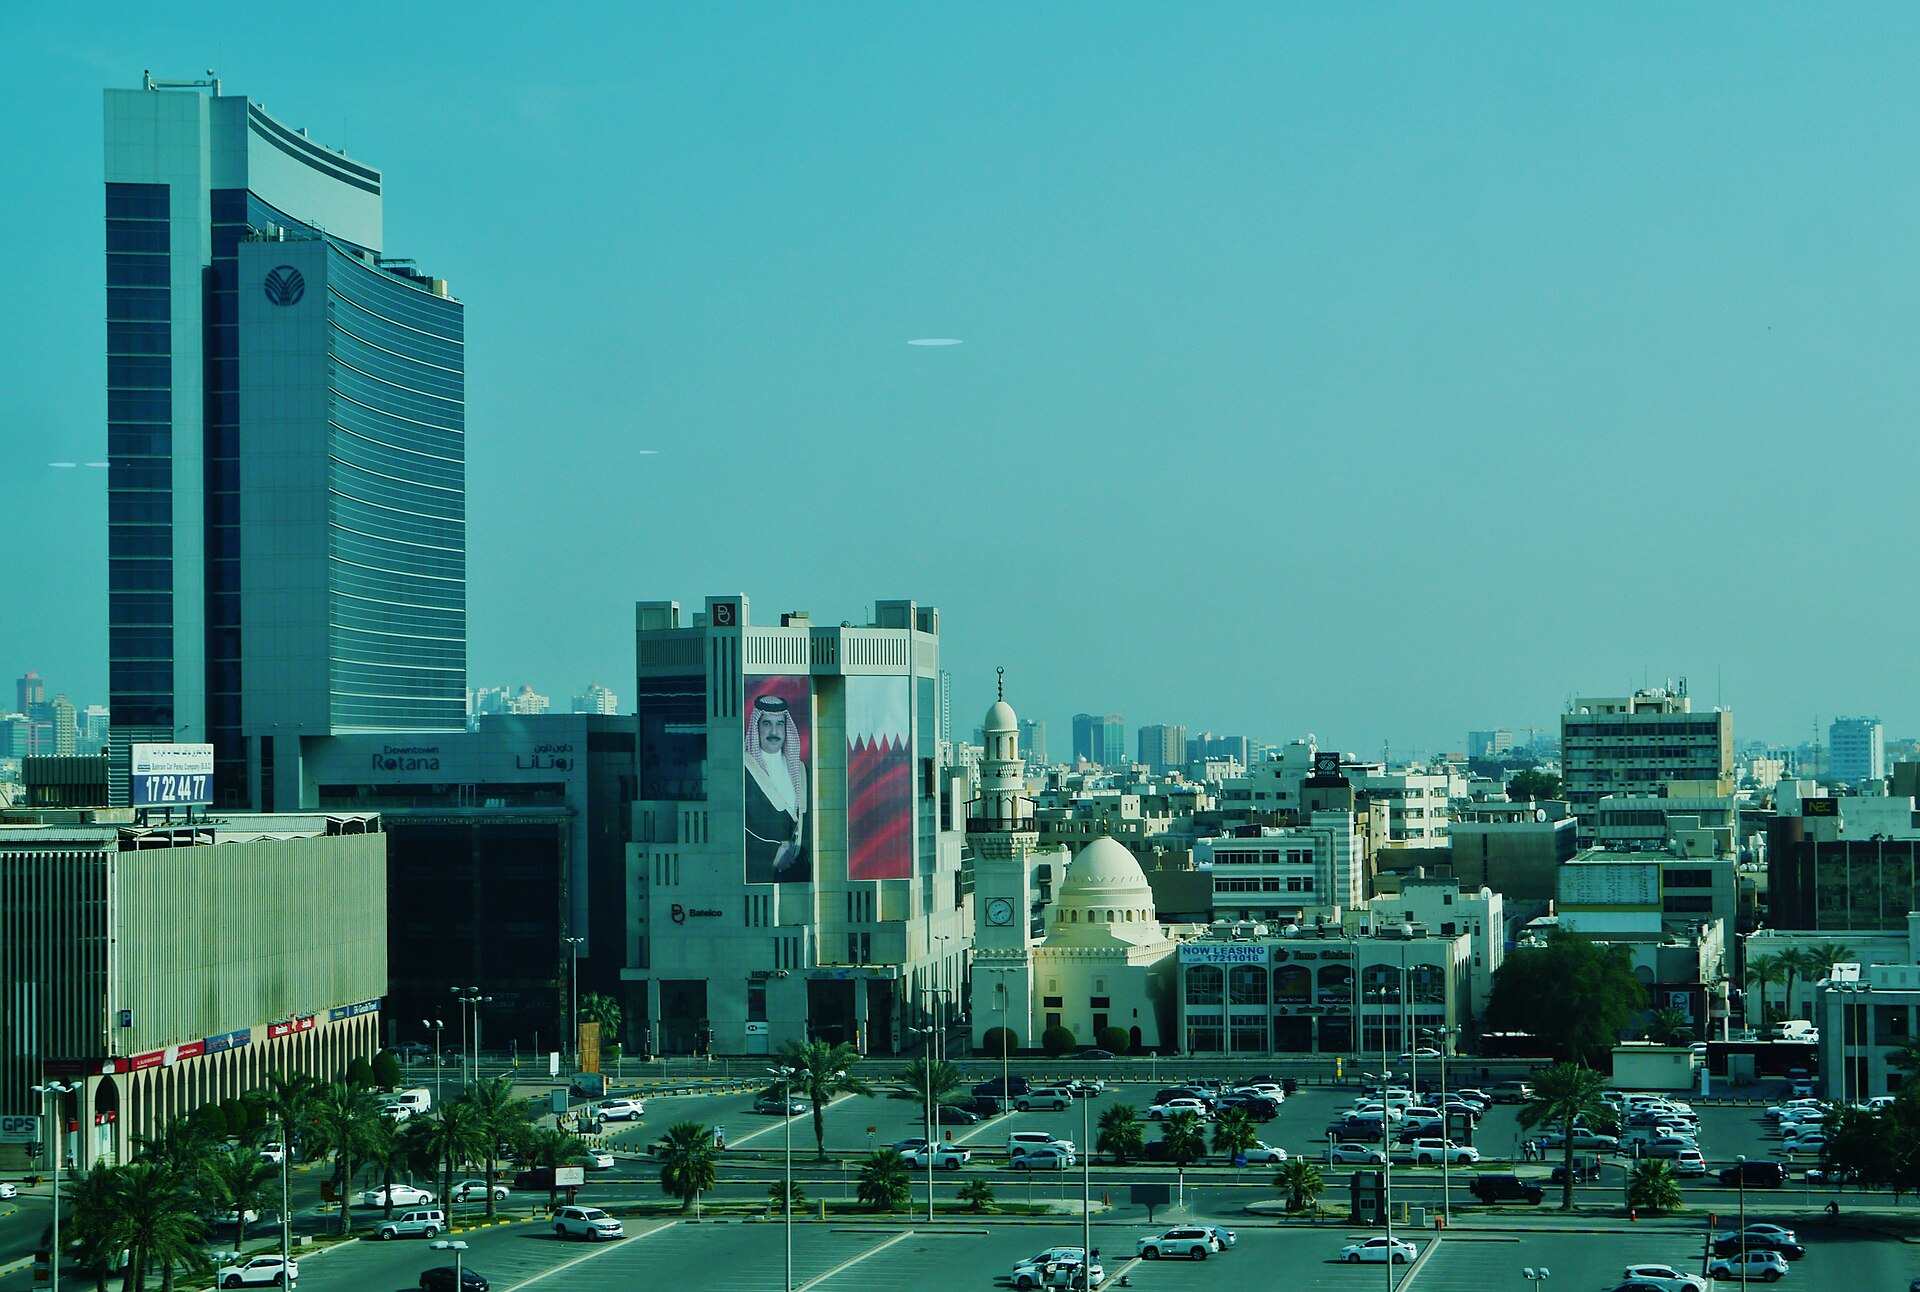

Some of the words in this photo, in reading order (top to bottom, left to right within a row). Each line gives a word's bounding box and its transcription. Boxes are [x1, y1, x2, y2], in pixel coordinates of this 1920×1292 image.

[384, 745, 439, 755] Downtown
[372, 754, 440, 770] Rotana
[516, 754, 574, 772] روتانا
[146, 776, 160, 801] 17
[162, 775, 176, 801] 22
[177, 775, 191, 801] 44
[193, 775, 206, 800] 77
[1808, 801, 1831, 812] NEC
[689, 908, 723, 917] Batelco
[1182, 946, 1210, 955] NOW
[1213, 946, 1265, 955] LEASING
[1206, 954, 1259, 962] 17211016
[751, 970, 775, 979] HSBC
[122, 1011, 131, 1026] P
[2, 1117, 36, 1132] GPS
